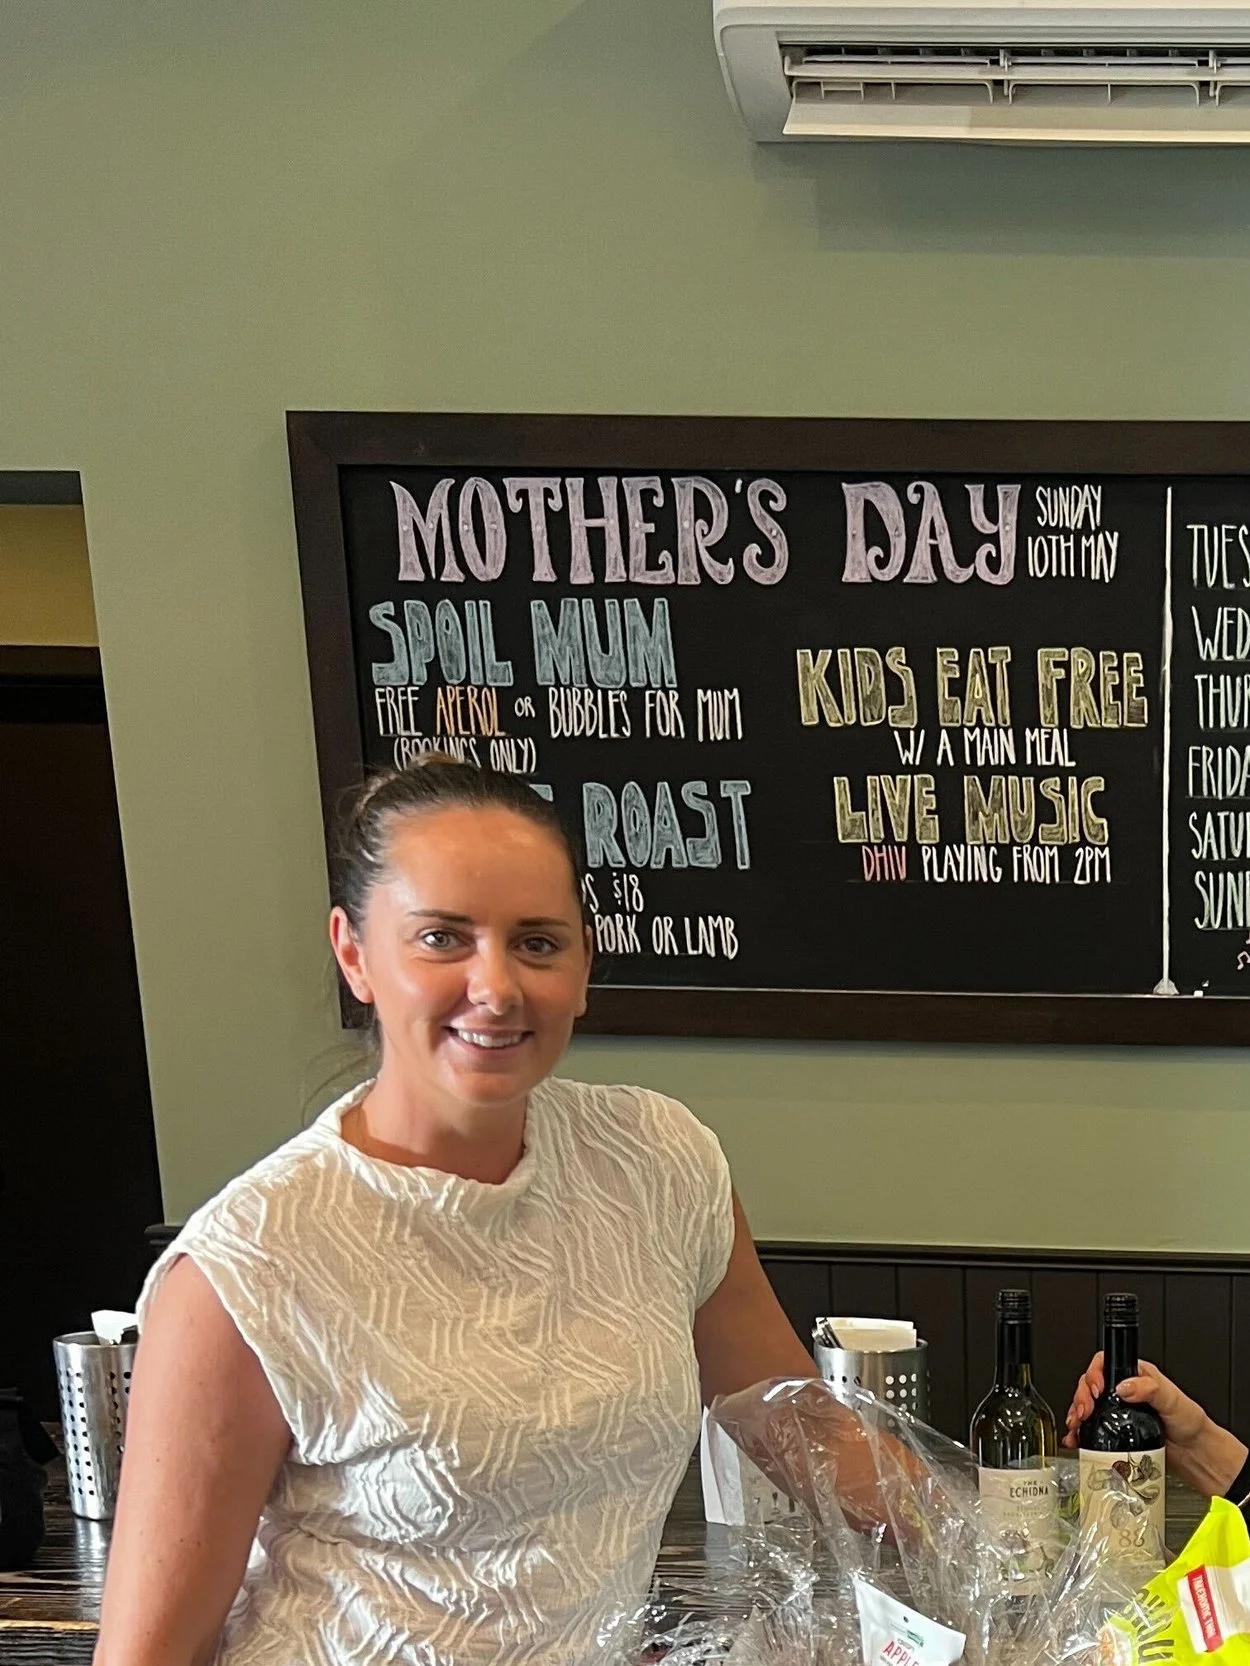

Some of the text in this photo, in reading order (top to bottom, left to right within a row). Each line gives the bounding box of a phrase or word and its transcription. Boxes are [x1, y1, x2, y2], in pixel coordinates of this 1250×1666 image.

[390, 476, 1021, 585] MOTHER'S DAY
[1035, 485, 1102, 529] SUNDAY
[1027, 531, 1119, 583] 10TH MAY
[369, 598, 679, 689] SPOIL MUM
[797, 646, 1149, 729] KIDS EAT FREE
[375, 686, 743, 742] FREE APEROL OR BUBBLES FOR MUM
[489, 736, 537, 774] ONLY)
[893, 728, 1077, 767] W/ A MAIN MEAL
[582, 780, 752, 871] ROAST
[833, 773, 1109, 845] LIVE MUSIC
[921, 843, 1003, 884] PLAYING
[1013, 845, 1060, 884] FROM
[1073, 845, 1112, 884] 2PM
[612, 872, 644, 913] $18
[594, 913, 740, 960] PORK OR LAMB
[1009, 1485, 1049, 1498] ECHIDNA
